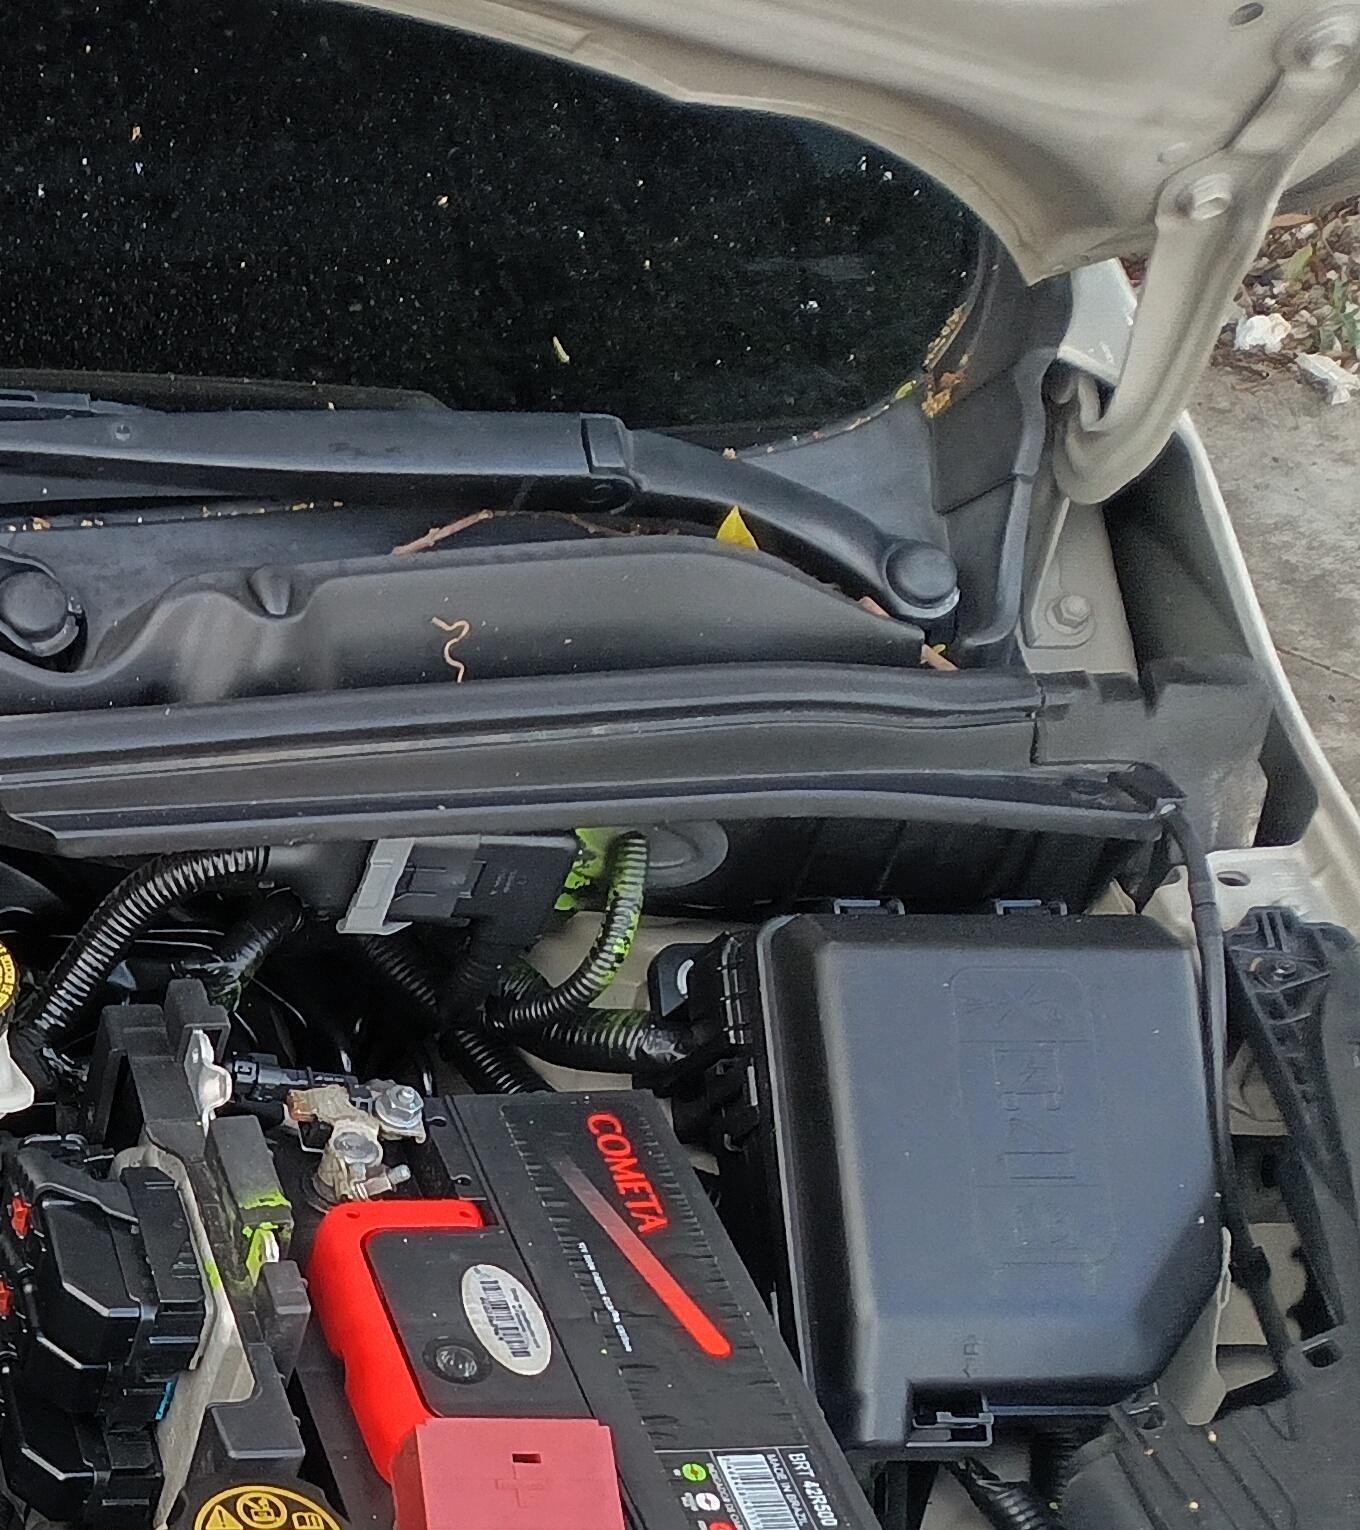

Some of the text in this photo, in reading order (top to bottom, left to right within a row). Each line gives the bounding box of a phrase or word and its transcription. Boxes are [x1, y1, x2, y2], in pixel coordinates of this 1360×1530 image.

[586, 1111, 669, 1234] COMETA
[766, 1453, 808, 1526] MADE IN BRAZIL
[788, 1452, 839, 1528] BRT 42R500
